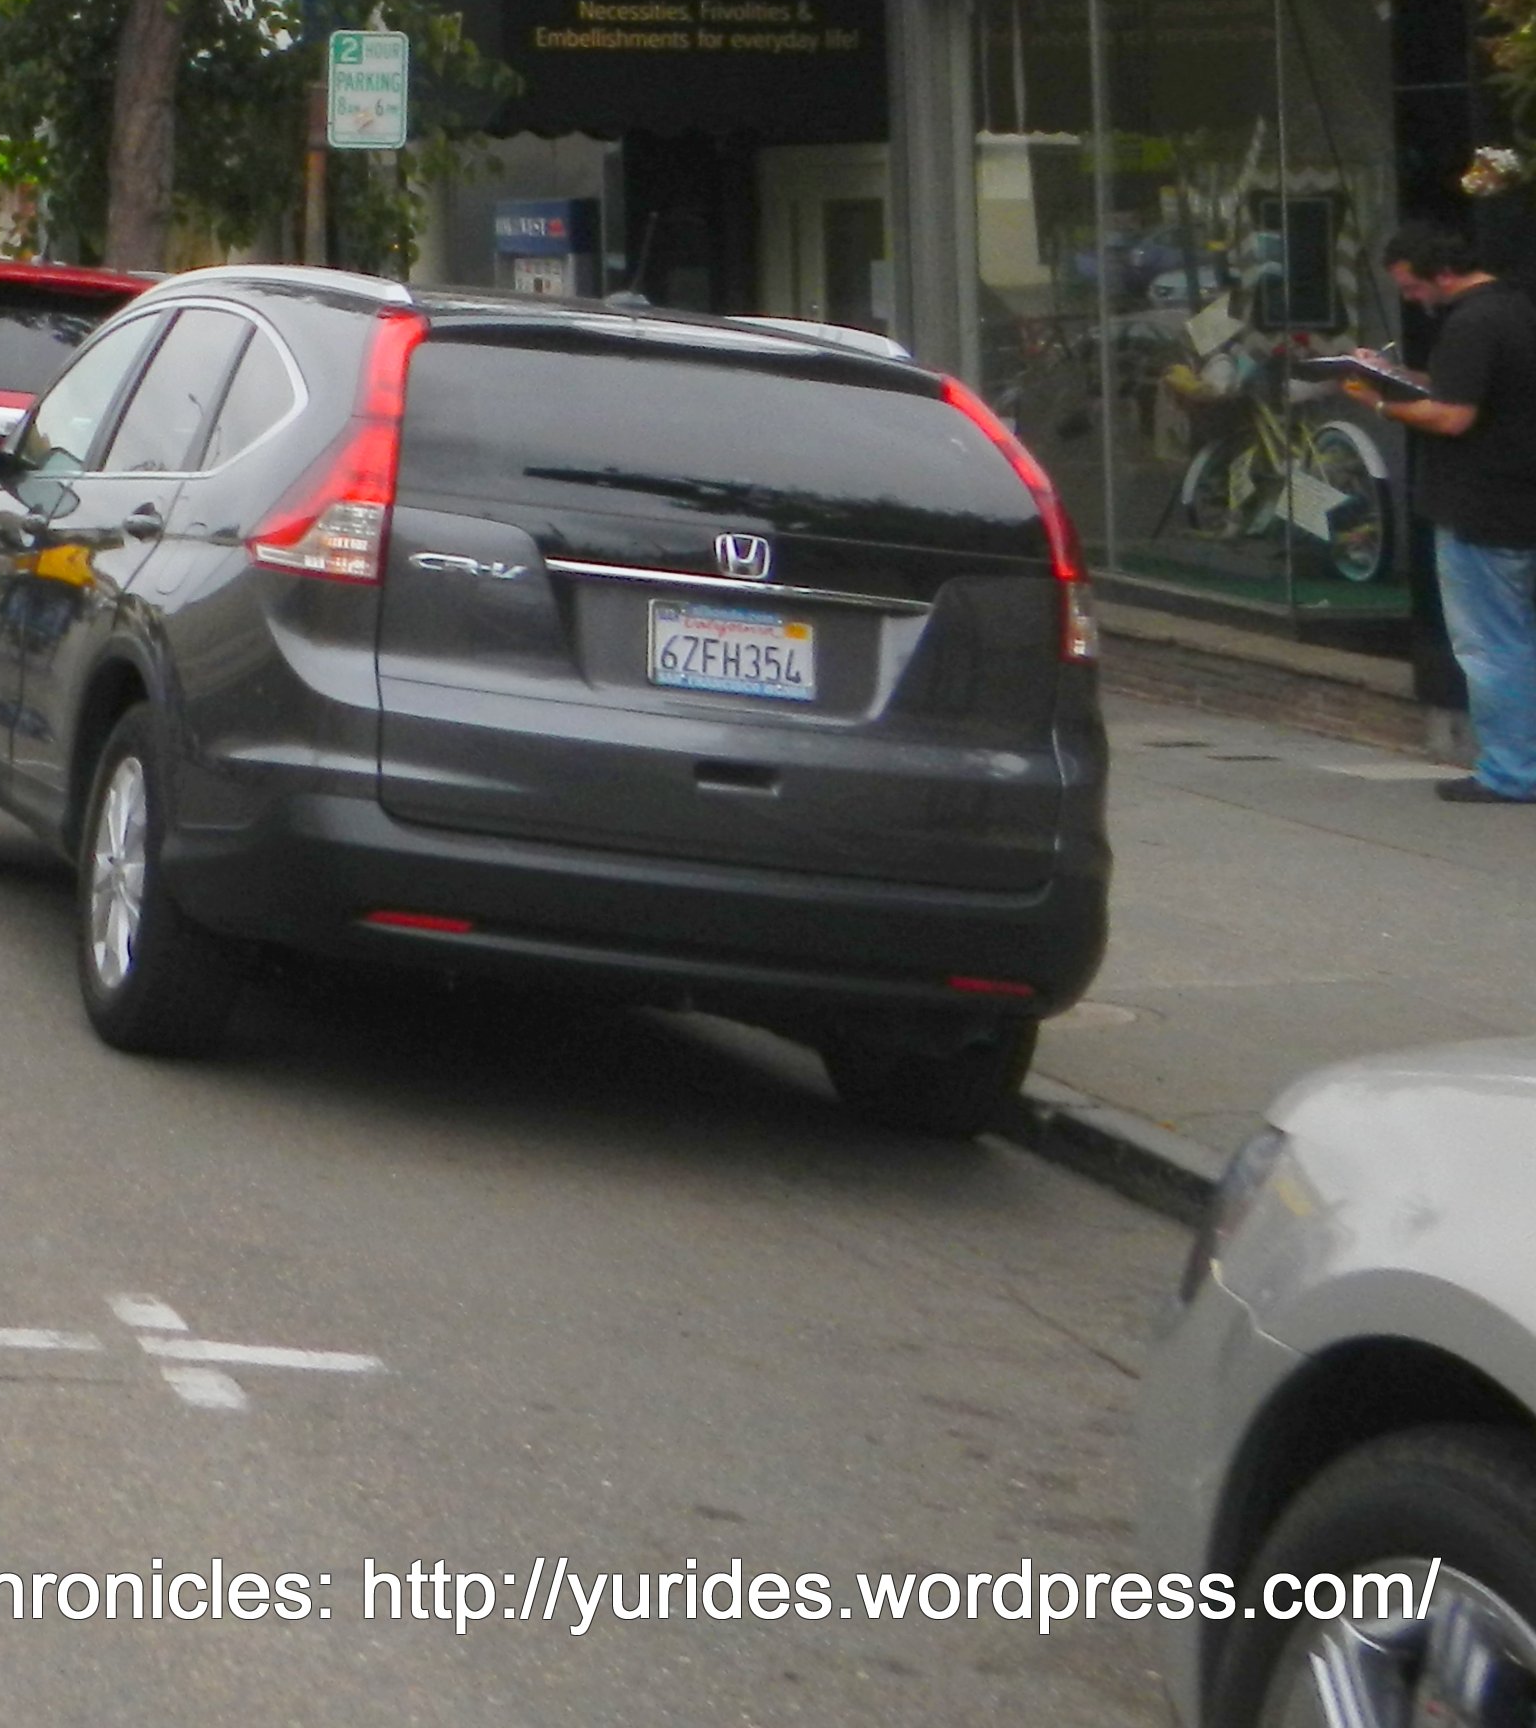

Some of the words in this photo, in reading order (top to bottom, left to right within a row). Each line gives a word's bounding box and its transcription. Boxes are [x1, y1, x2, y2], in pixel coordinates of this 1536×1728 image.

[700, 0, 790, 21] Frivolities
[796, 1, 813, 21] &
[341, 38, 358, 61] 2
[365, 42, 400, 59] HOUR
[535, 27, 689, 49] Embellishments
[697, 29, 723, 49] for
[730, 31, 820, 53] everyday
[336, 72, 401, 92] PARKING
[409, 552, 527, 579] CR-V
[661, 635, 801, 684] 6ZFH354
